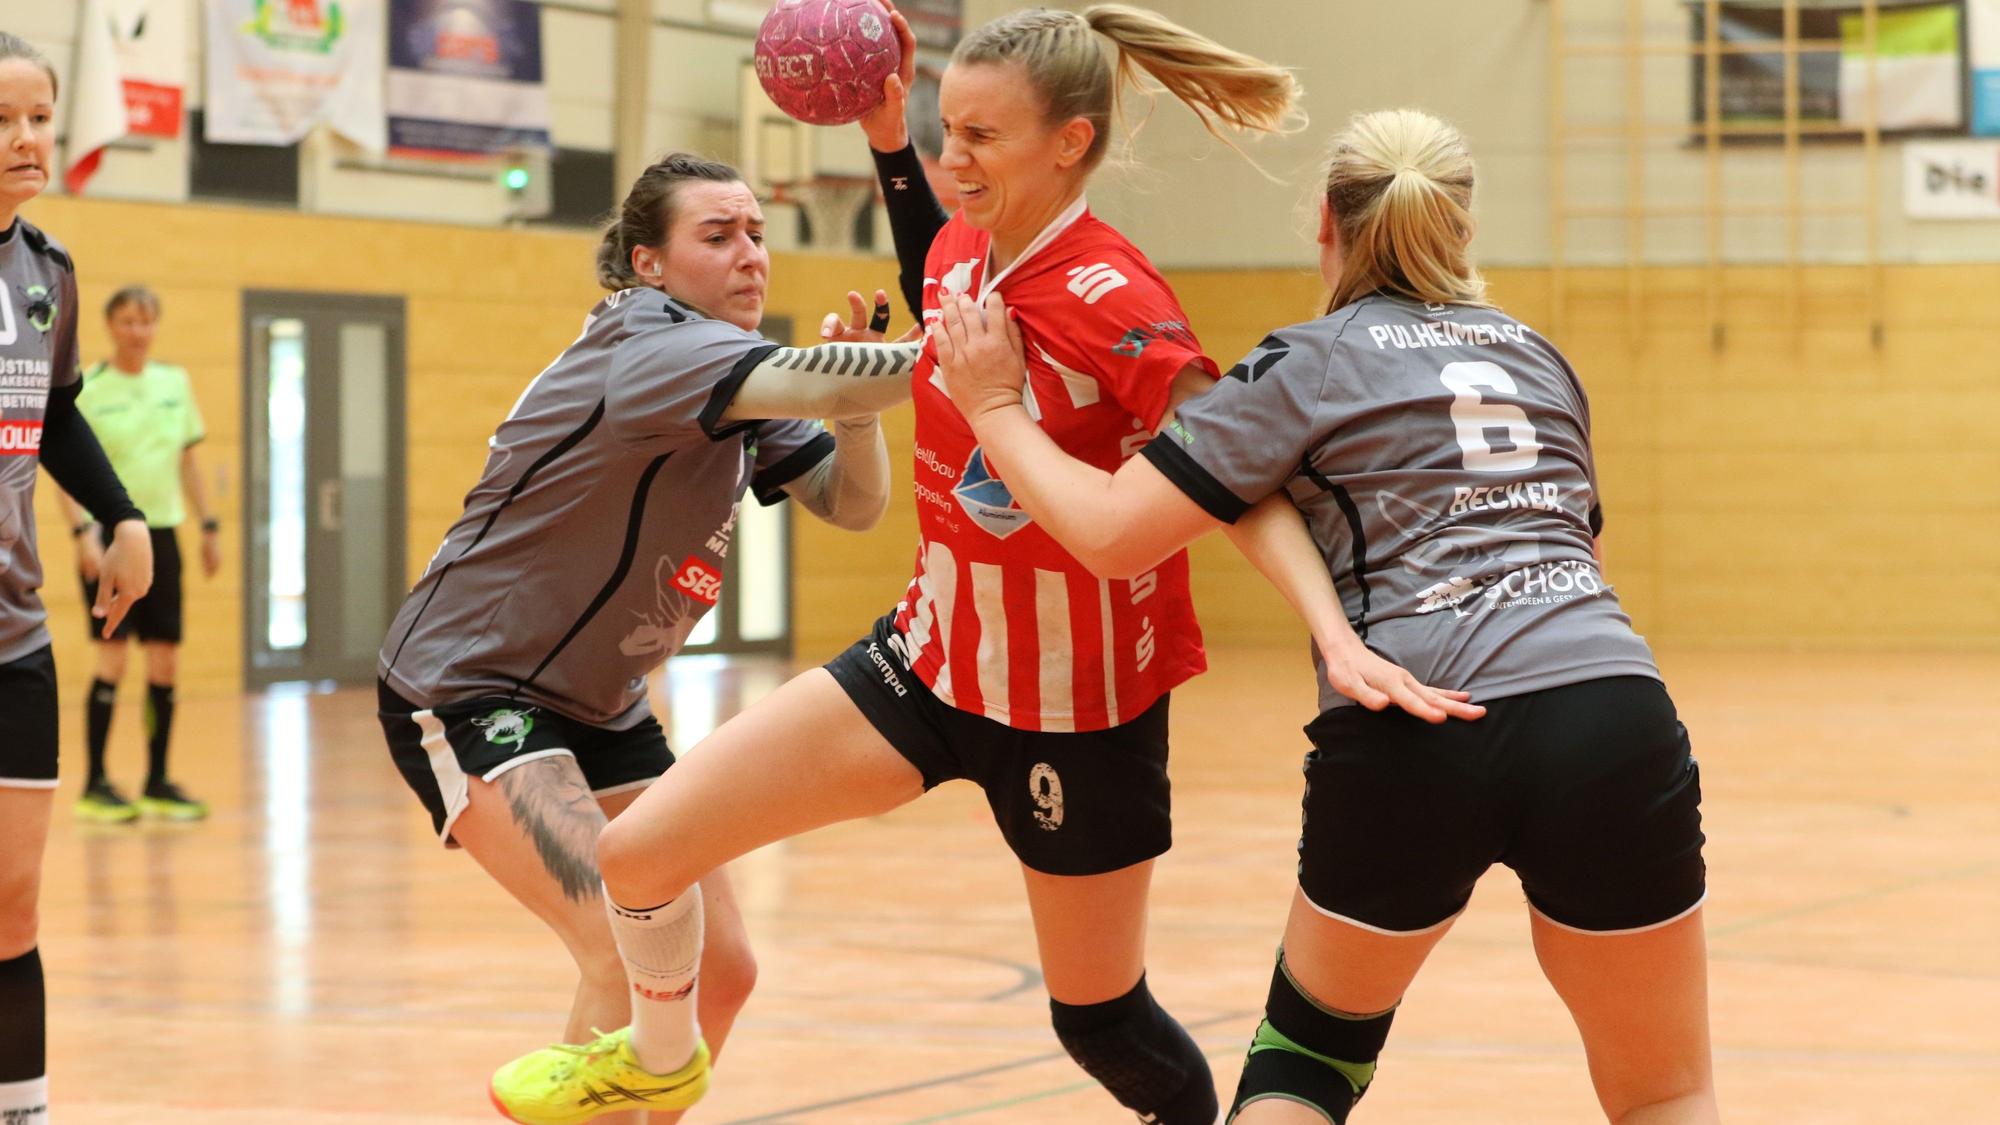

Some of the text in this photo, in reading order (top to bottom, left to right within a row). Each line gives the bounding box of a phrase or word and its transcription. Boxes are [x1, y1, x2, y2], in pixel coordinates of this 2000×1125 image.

[1925, 161, 1986, 194] Die
[1368, 320, 1507, 350] PULHEIMER
[1440, 361, 1544, 471] 6
[1450, 481, 1563, 517] BECKER
[866, 641, 908, 698] Kempa
[1029, 761, 1065, 832] 9
